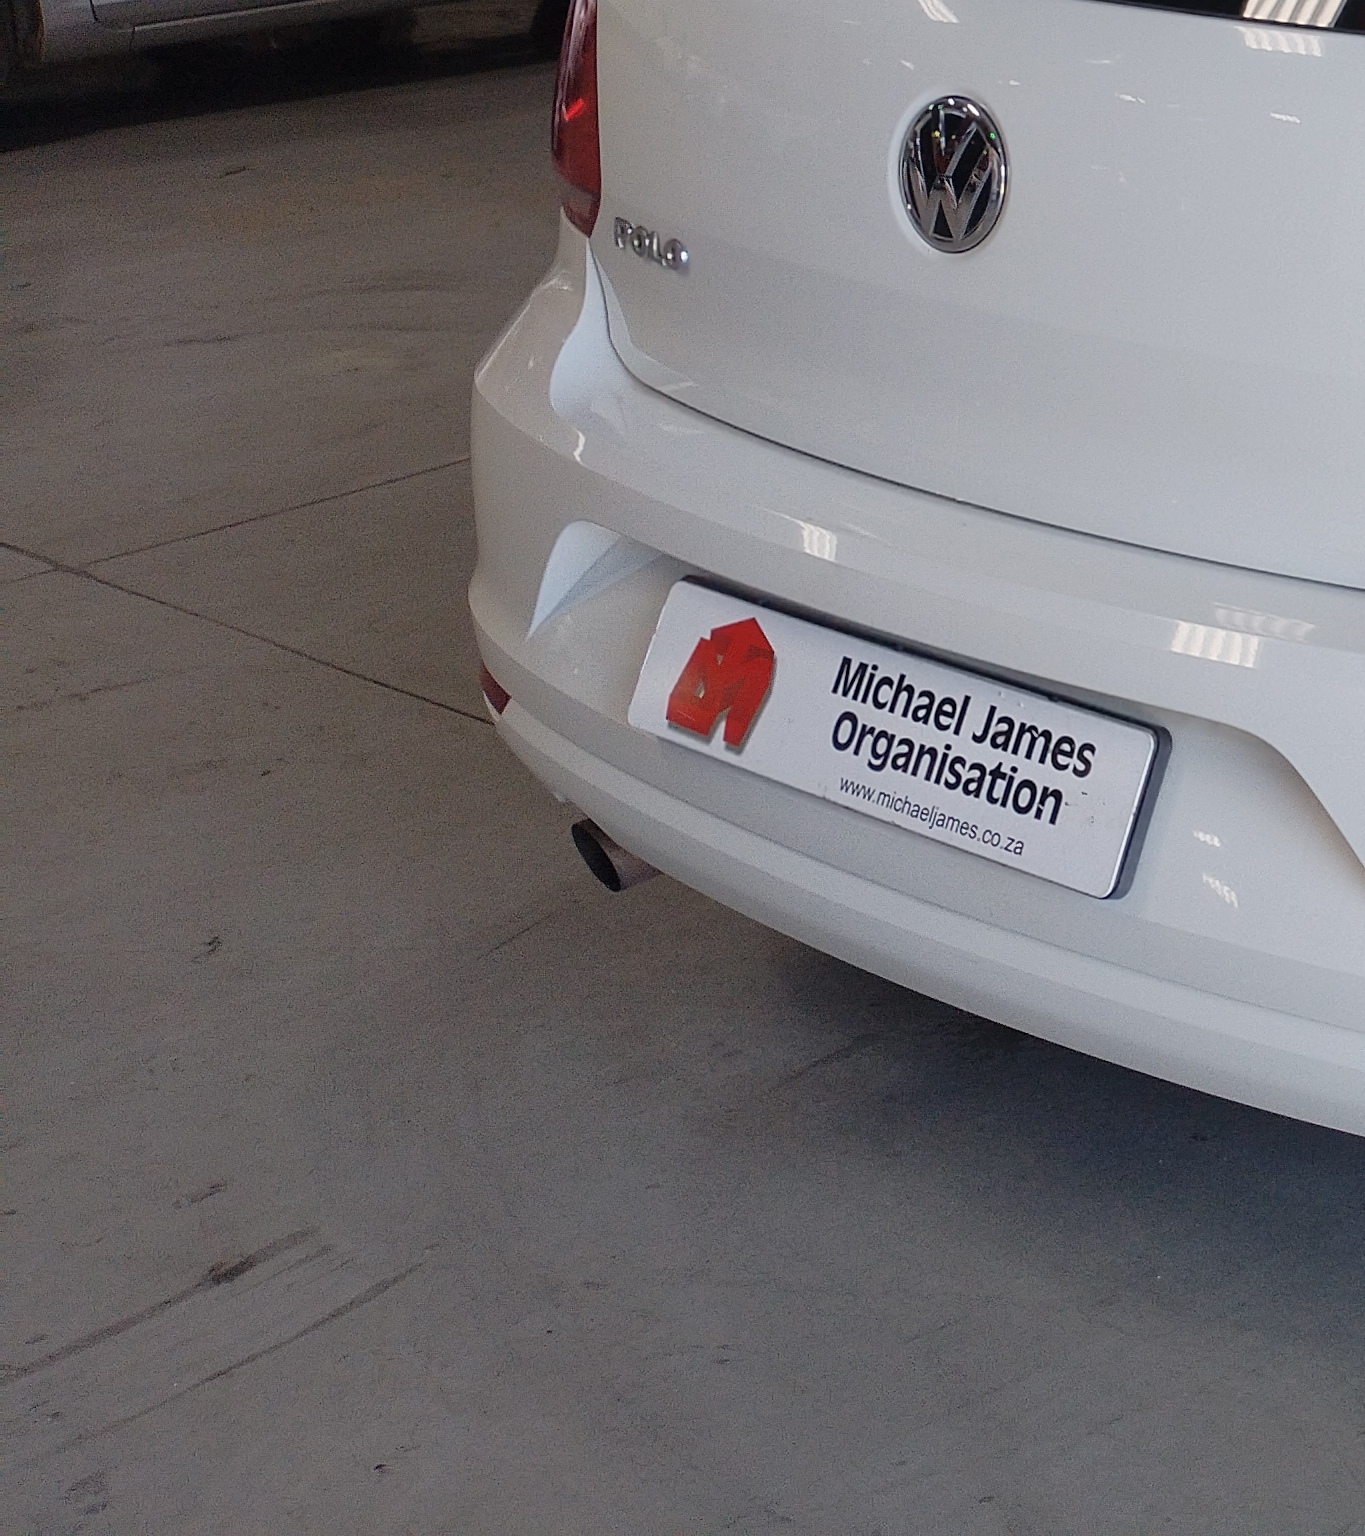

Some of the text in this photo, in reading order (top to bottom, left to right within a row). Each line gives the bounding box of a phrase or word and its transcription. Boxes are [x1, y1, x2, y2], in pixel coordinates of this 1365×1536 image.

[831, 655, 1097, 779] Michael James
[832, 710, 1065, 826] Organisation
[839, 776, 1025, 856] www.michaeljames.co.za
